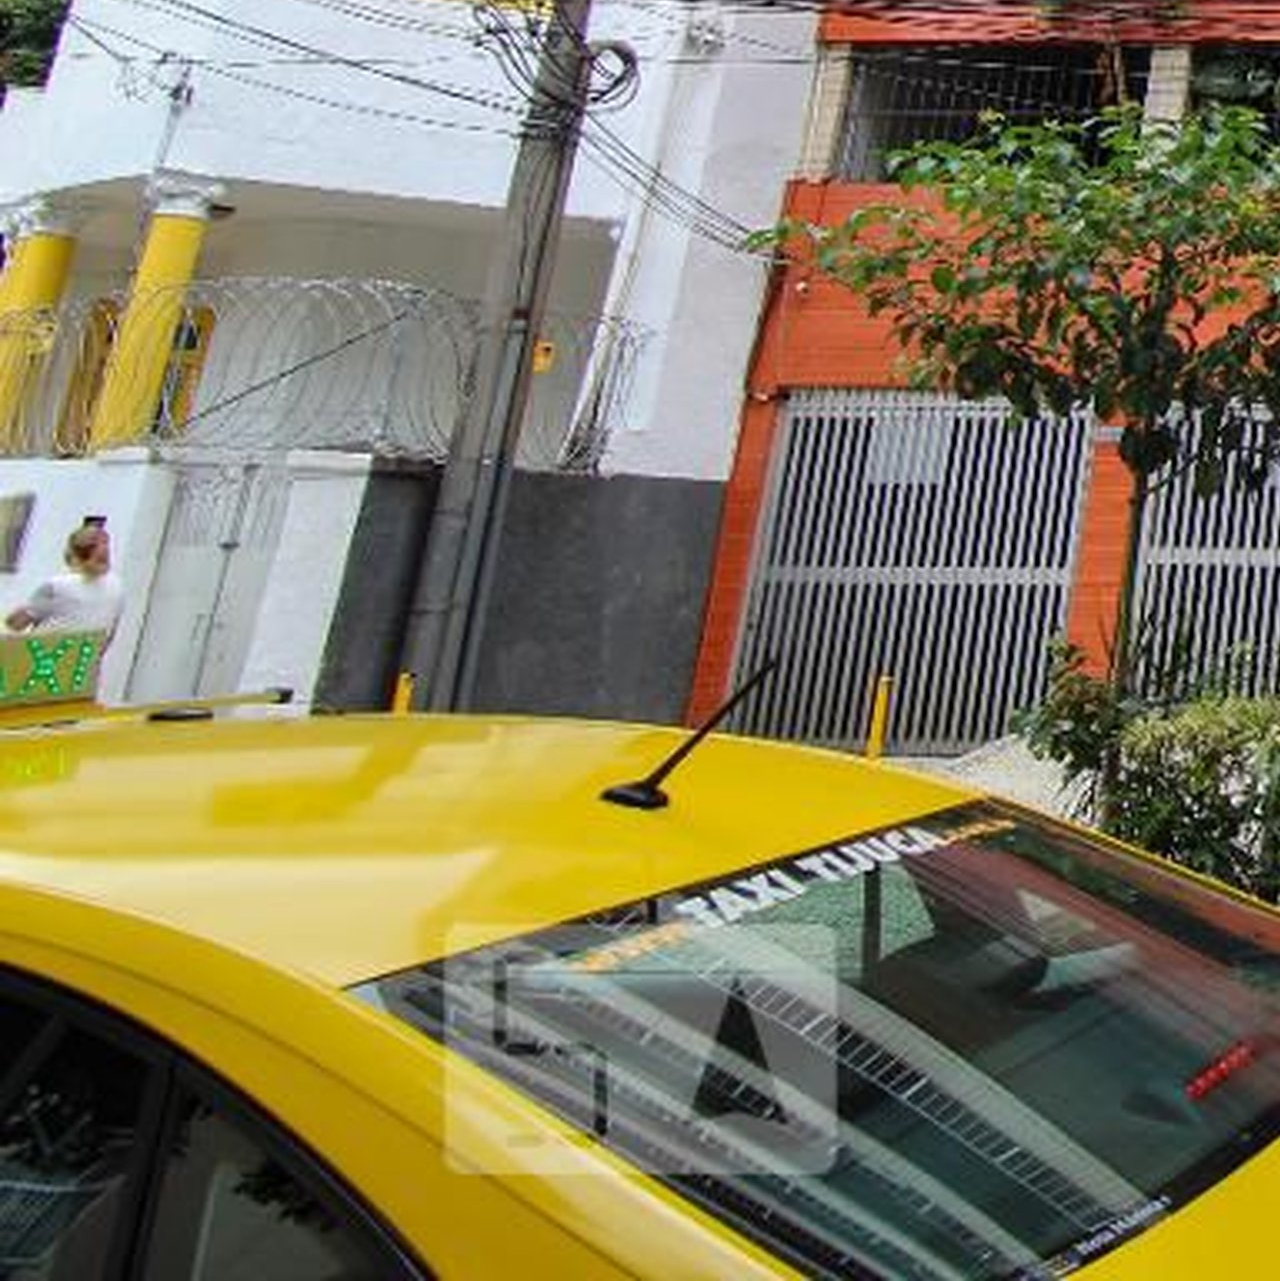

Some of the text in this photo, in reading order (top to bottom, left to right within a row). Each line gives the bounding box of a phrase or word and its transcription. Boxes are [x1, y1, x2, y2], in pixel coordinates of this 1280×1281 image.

[0, 638, 93, 696] XI
[674, 869, 806, 929] TAXI
[794, 826, 941, 881] TIJUCA
